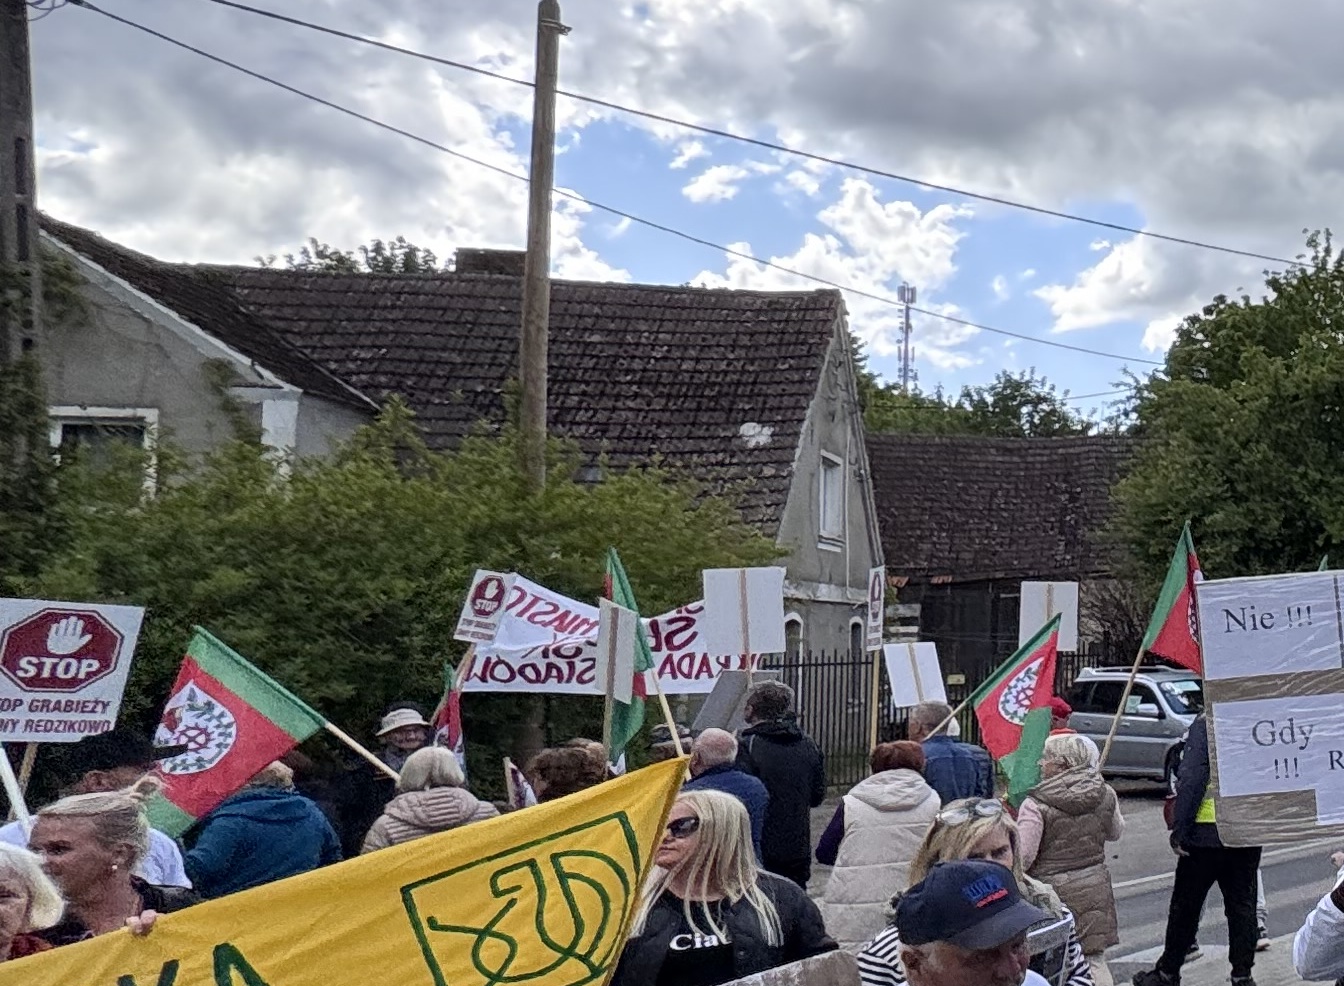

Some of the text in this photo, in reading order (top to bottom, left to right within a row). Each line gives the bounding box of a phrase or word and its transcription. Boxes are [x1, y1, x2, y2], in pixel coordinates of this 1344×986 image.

[1223, 605, 1314, 633] Nie !!!
[16, 656, 101, 679] STOP
[23, 719, 112, 734] REDZIKOWO
[1251, 718, 1315, 751] Gdy
[1273, 757, 1300, 780] !!!
